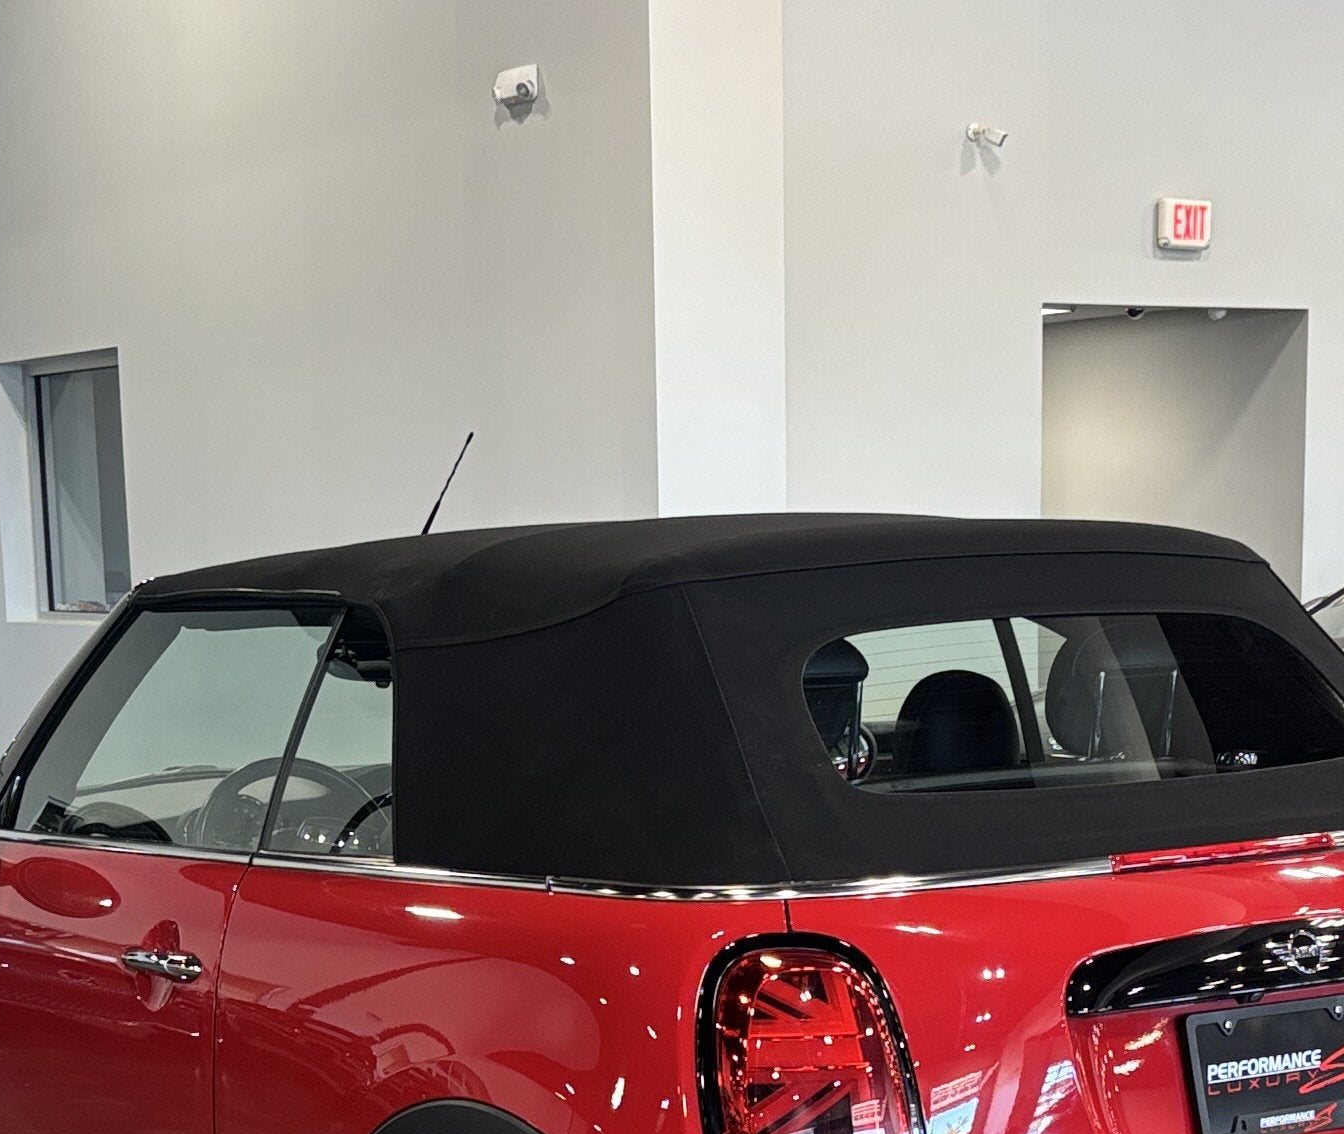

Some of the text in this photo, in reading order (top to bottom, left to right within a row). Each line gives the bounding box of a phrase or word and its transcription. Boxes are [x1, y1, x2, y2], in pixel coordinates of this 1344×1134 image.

[1173, 204, 1208, 241] EXIT
[1207, 1049, 1322, 1082] PERFORMANCE
[1208, 1070, 1320, 1096] LUXURY
